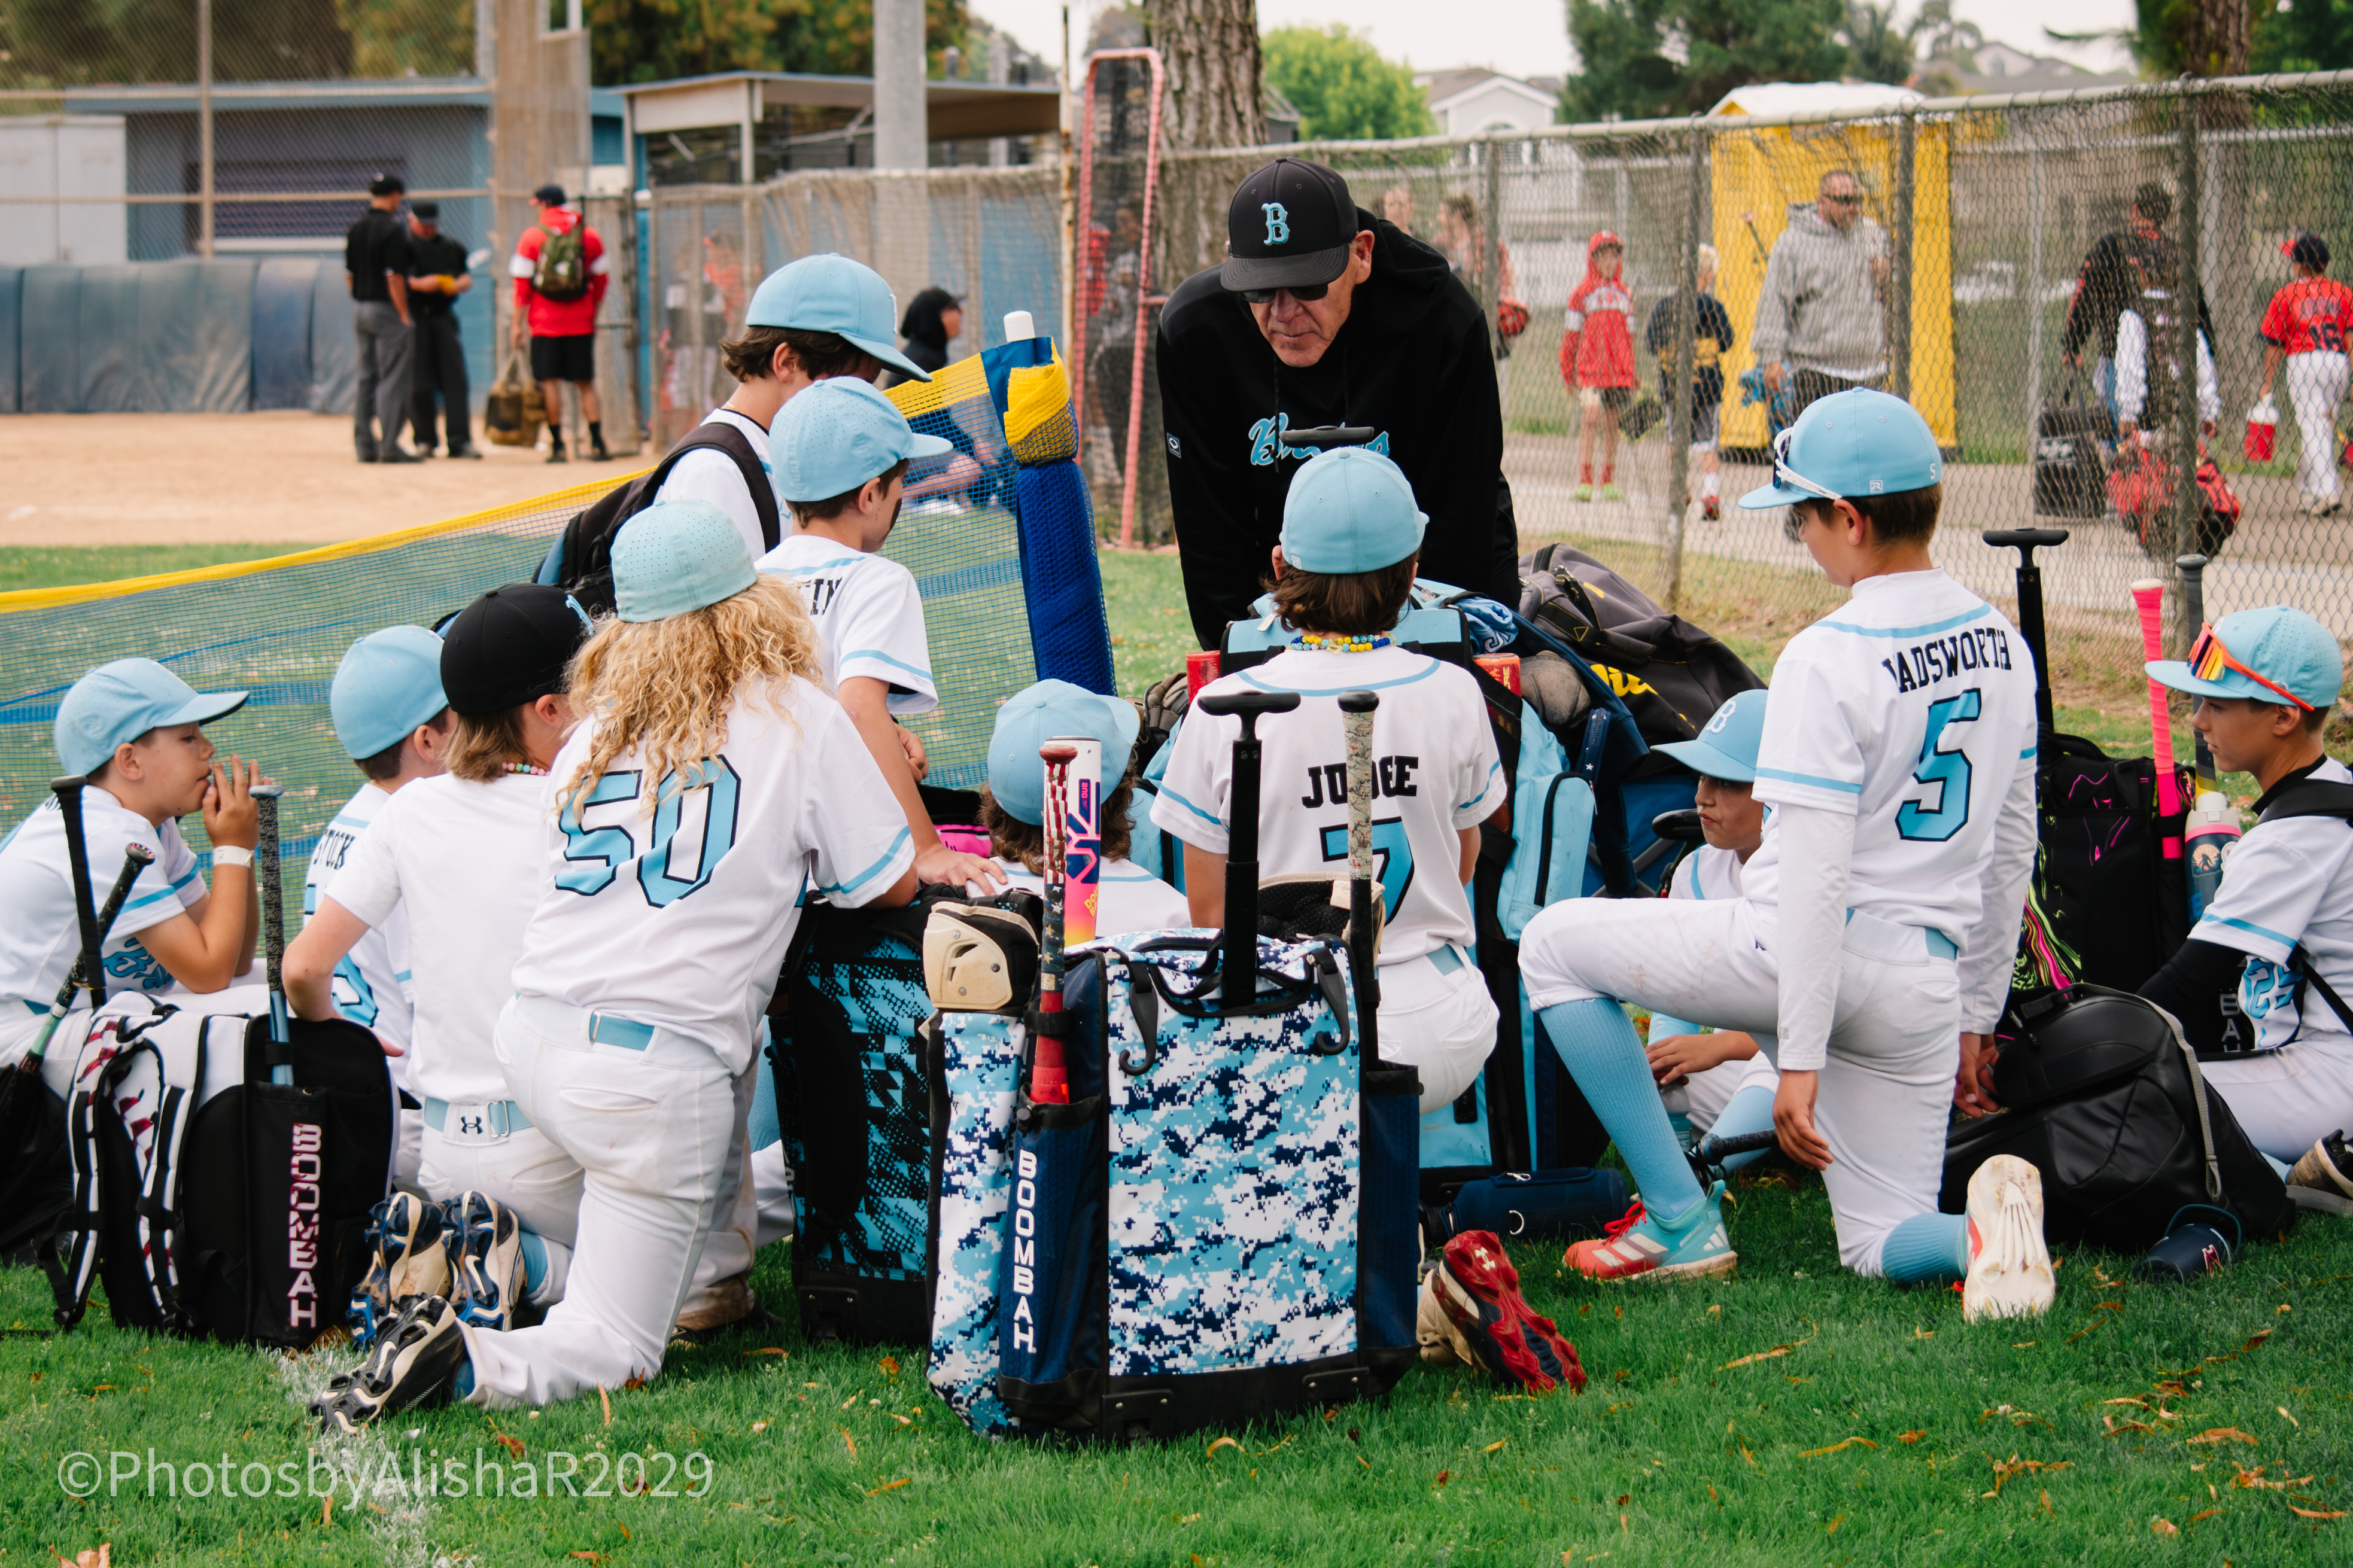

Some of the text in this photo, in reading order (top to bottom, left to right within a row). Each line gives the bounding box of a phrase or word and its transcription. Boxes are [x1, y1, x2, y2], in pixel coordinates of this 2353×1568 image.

[1261, 202, 1290, 246] B
[1929, 463, 1936, 480] 5
[1706, 699, 1737, 734] B
[1895, 687, 1981, 842] 5
[555, 754, 741, 909] 50
[1301, 755, 1419, 809] JUGE
[1318, 815, 1415, 928] 7
[288, 1122, 322, 1329] BOOMBAH
[1013, 1149, 1037, 1353] BOOMBAH
